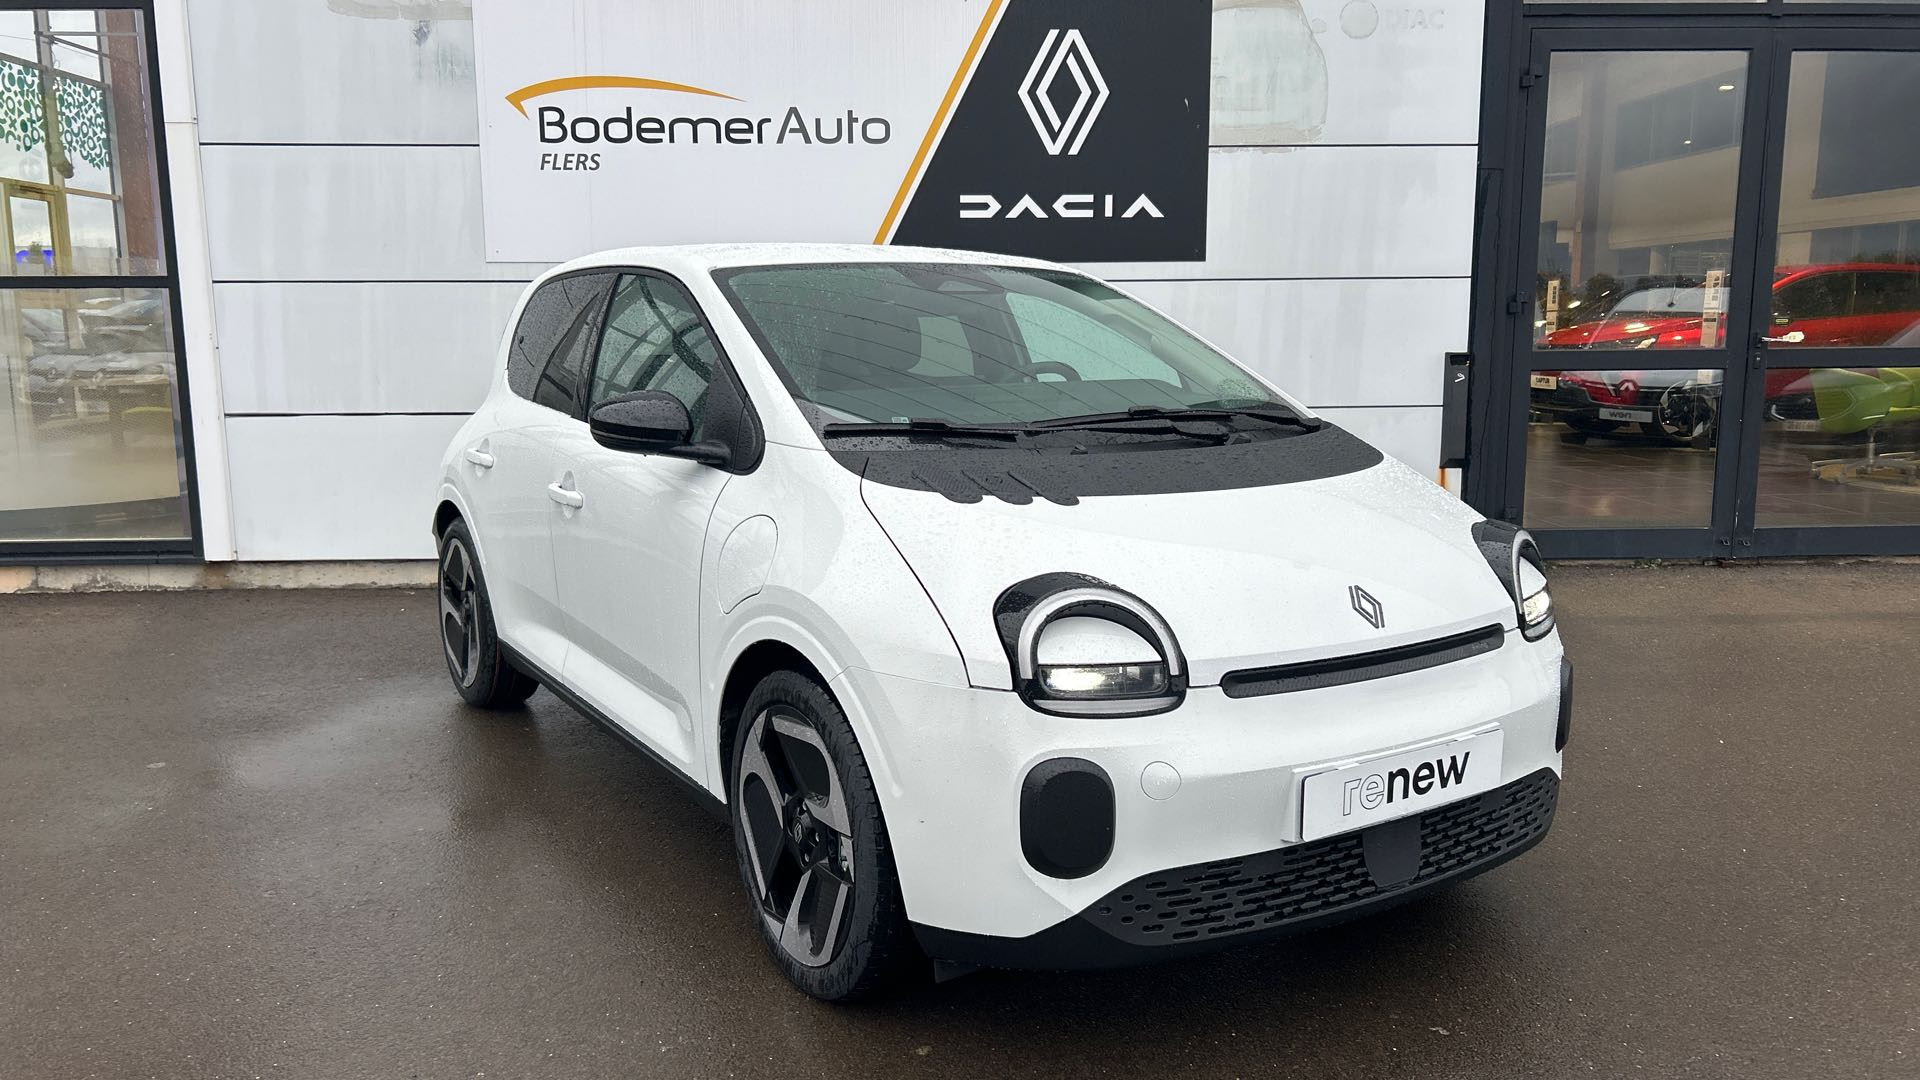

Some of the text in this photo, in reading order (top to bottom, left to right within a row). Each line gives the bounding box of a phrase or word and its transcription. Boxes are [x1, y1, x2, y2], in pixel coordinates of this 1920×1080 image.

[540, 153, 601, 171] FLERS
[959, 193, 1165, 219] DACIA
[1342, 751, 1471, 816] renew
